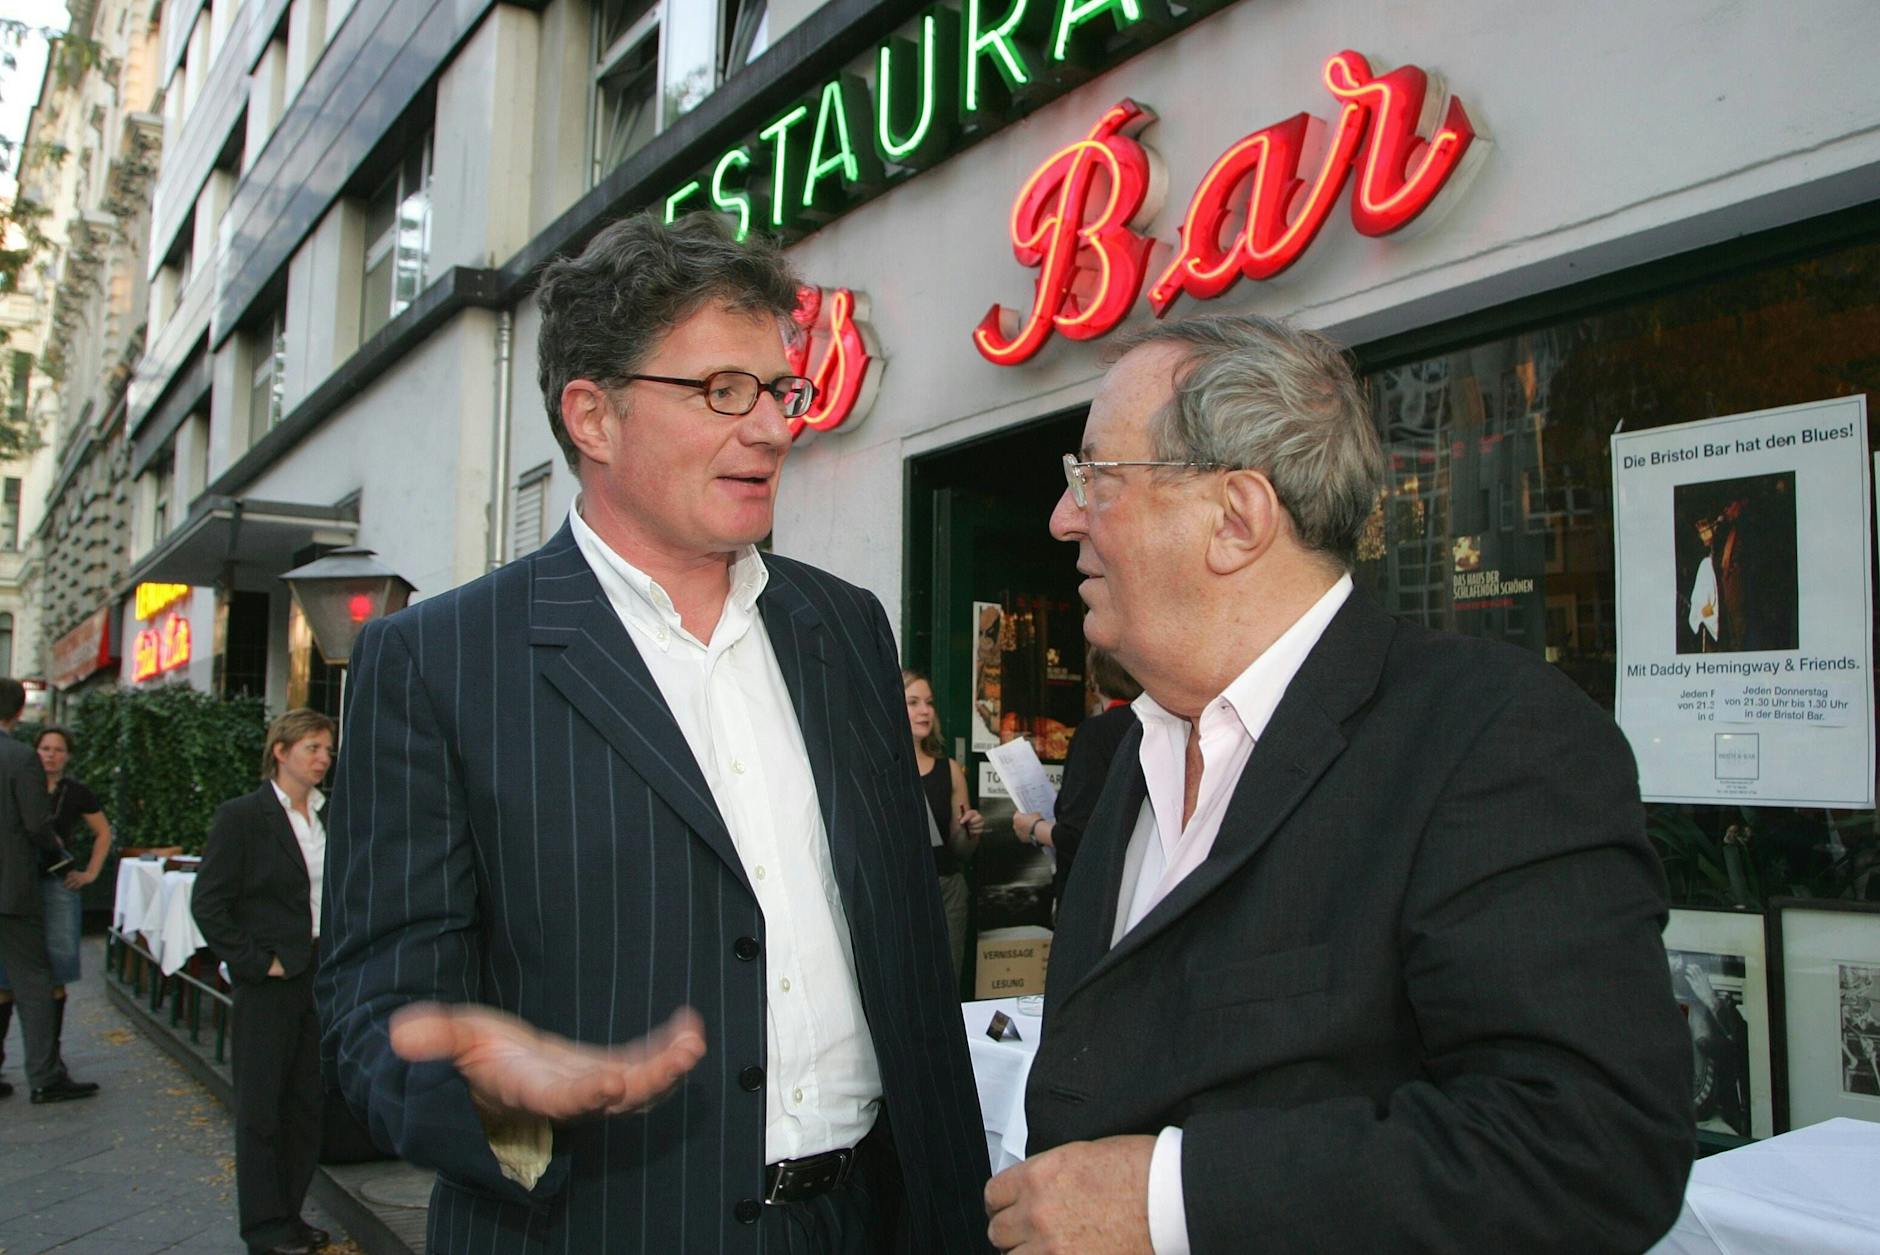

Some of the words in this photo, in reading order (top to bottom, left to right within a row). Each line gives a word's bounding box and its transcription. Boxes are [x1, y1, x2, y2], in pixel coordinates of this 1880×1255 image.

[973, 49, 1478, 366] Bar
[1623, 455, 1646, 470] Die
[1650, 445, 1699, 465] Bristol
[1703, 444, 1730, 458] Bar
[1735, 437, 1761, 453] hat
[1766, 431, 1796, 448] den
[1801, 423, 1854, 444] Blues!
[1453, 574, 1466, 587] DAS
[1467, 572, 1485, 585] HAUS
[1486, 570, 1500, 583] DER
[1453, 583, 1500, 599] SCHLAFENDEN
[1500, 578, 1534, 595] SCHÖNEN
[1627, 664, 1646, 677] Mit
[1650, 661, 1691, 678] Daddy
[1696, 657, 1780, 676] Hemingway
[1785, 659, 1796, 672] &
[1800, 655, 1860, 671] Friends.
[1680, 689, 1709, 699] Jeden
[1742, 686, 1772, 696] Jeden
[1774, 686, 1828, 698] Donnerstag
[1678, 702, 1694, 710] von
[1724, 698, 1741, 706] von
[1744, 697, 1769, 707] 21.30
[1772, 698, 1788, 708] Uhr
[1791, 699, 1806, 708] bis
[1808, 699, 1827, 709] 1.30
[1830, 700, 1848, 710] Uhr
[1697, 713, 1706, 721] in
[1744, 710, 1753, 719] in
[1755, 710, 1771, 719] der
[1774, 710, 1805, 720] Bristol
[1807, 712, 1825, 721] Bar.
[982, 948, 1034, 960] VERNISSAGE
[991, 978, 1025, 990] LESUNG
